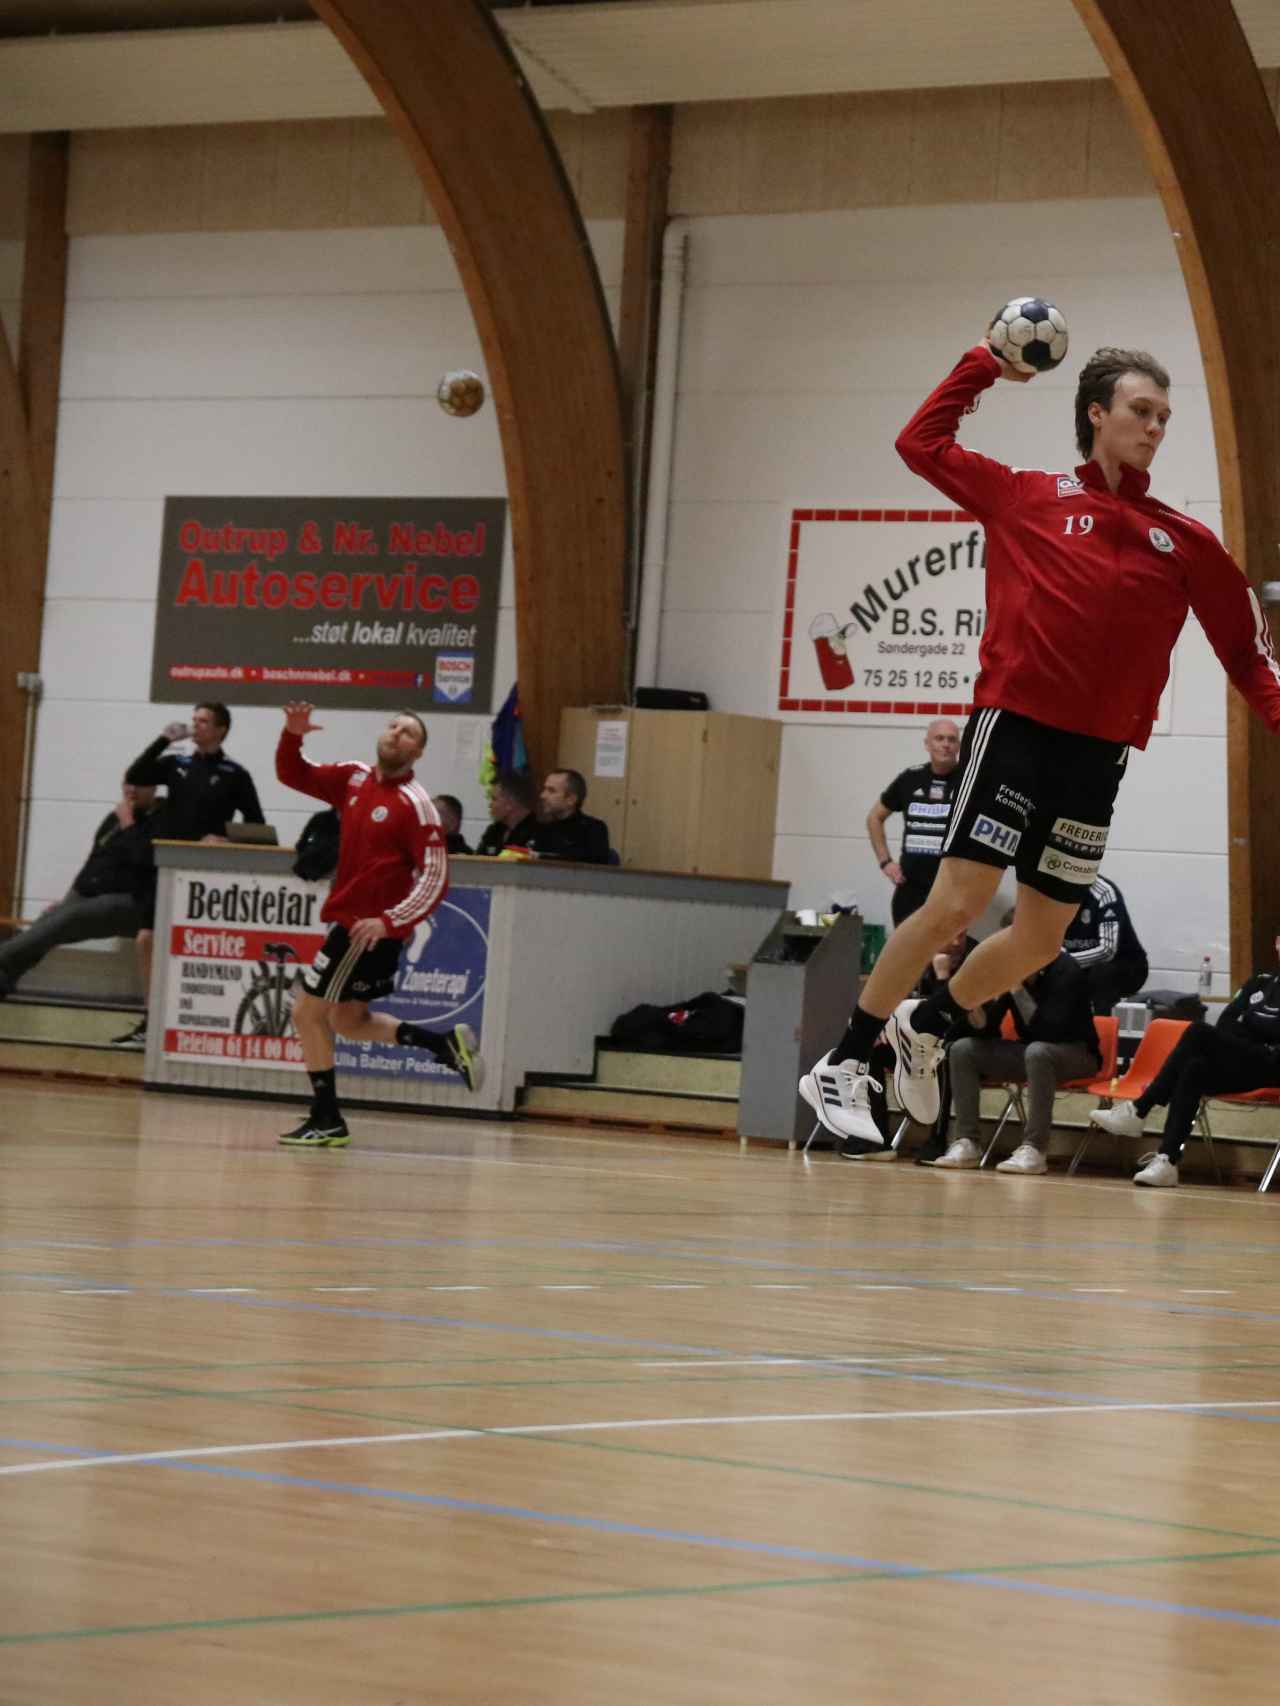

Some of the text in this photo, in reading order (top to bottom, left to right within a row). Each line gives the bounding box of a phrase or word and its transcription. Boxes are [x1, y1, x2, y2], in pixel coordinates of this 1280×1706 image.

[1063, 514, 1095, 535] 19
[178, 520, 486, 561] Outrup & Nr. Nebel
[175, 558, 481, 613] Autoservice
[351, 621, 403, 645] lokal
[406, 623, 478, 648] kvalitet
[891, 607, 987, 636] B.S. Ri
[877, 641, 966, 659] Søndergade 22
[863, 669, 958, 688] 75 25 12 65
[186, 881, 318, 927] Bedstefar
[182, 928, 247, 958] Service
[401, 965, 471, 999] Zoneterapi
